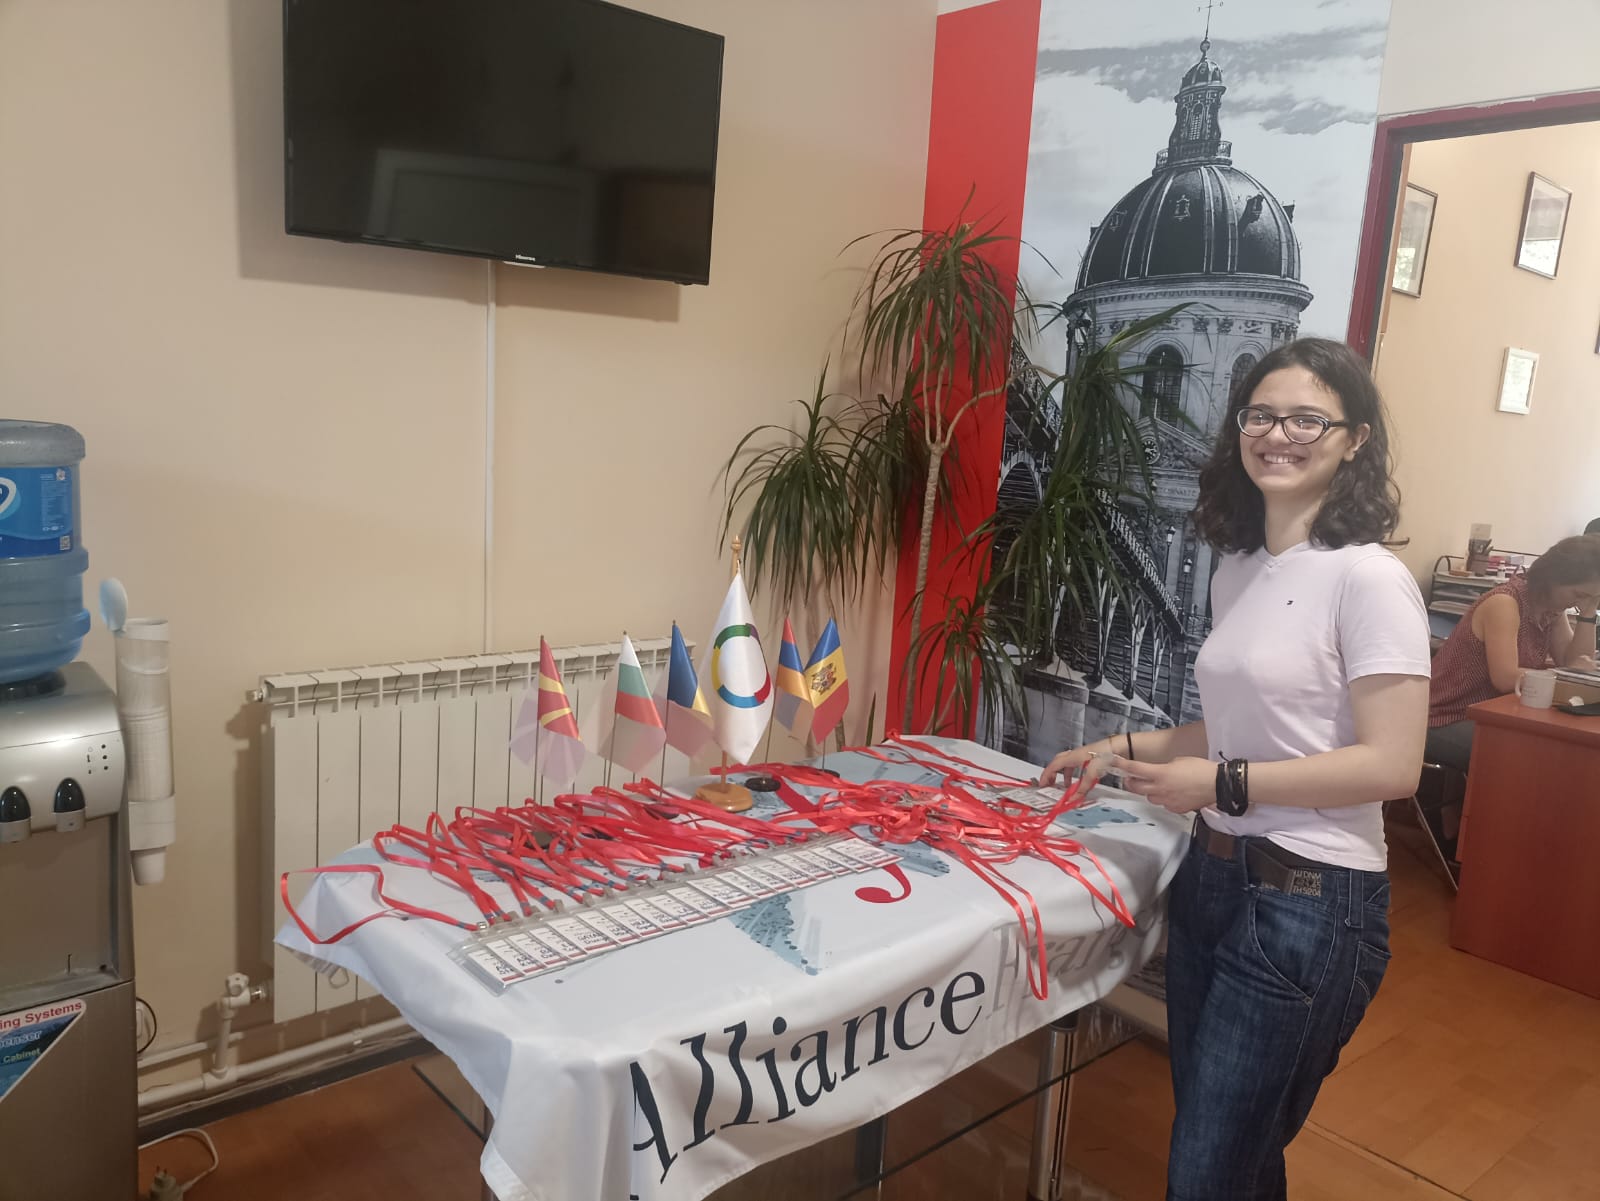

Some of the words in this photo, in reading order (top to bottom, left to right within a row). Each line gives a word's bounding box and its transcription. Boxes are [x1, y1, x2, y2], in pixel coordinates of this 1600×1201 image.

[25, 1002, 82, 1023] Systems
[3, 1048, 40, 1064] Cabinet
[629, 970, 986, 1185] Alliance
